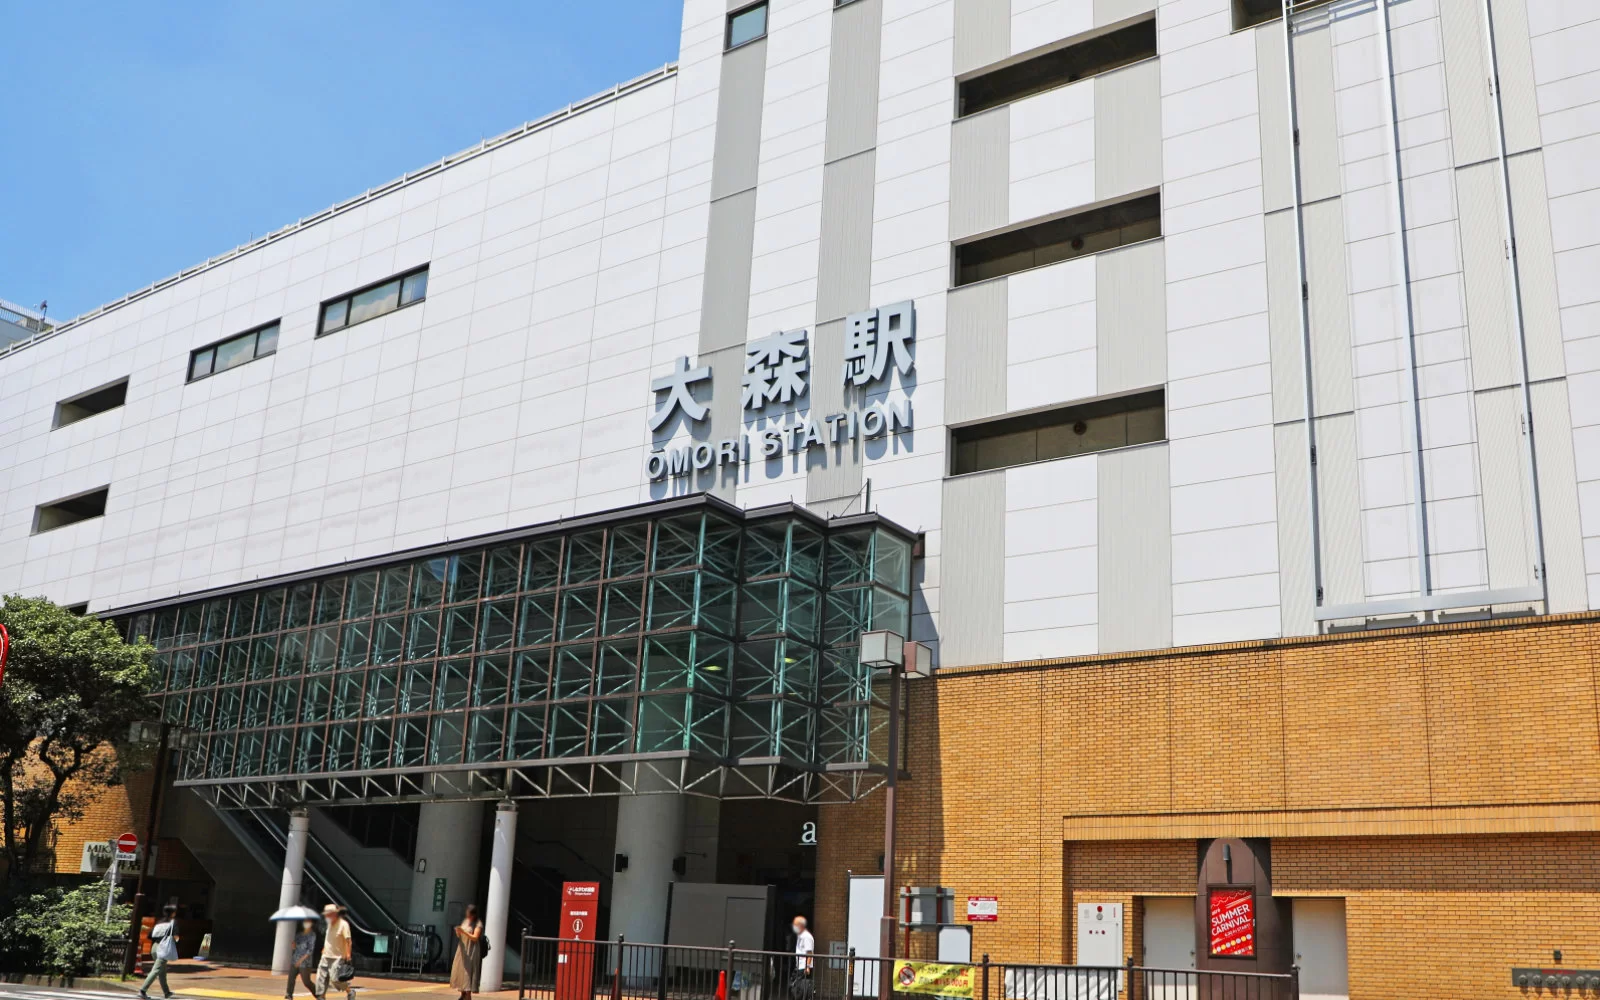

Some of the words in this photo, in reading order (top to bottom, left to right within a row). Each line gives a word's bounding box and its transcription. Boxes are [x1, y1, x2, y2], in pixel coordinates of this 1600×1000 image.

[648, 300, 915, 432] 大森駅
[760, 399, 914, 460] STATION
[1211, 904, 1250, 927] SUMMER
[1211, 914, 1252, 936] CARNIVAL
